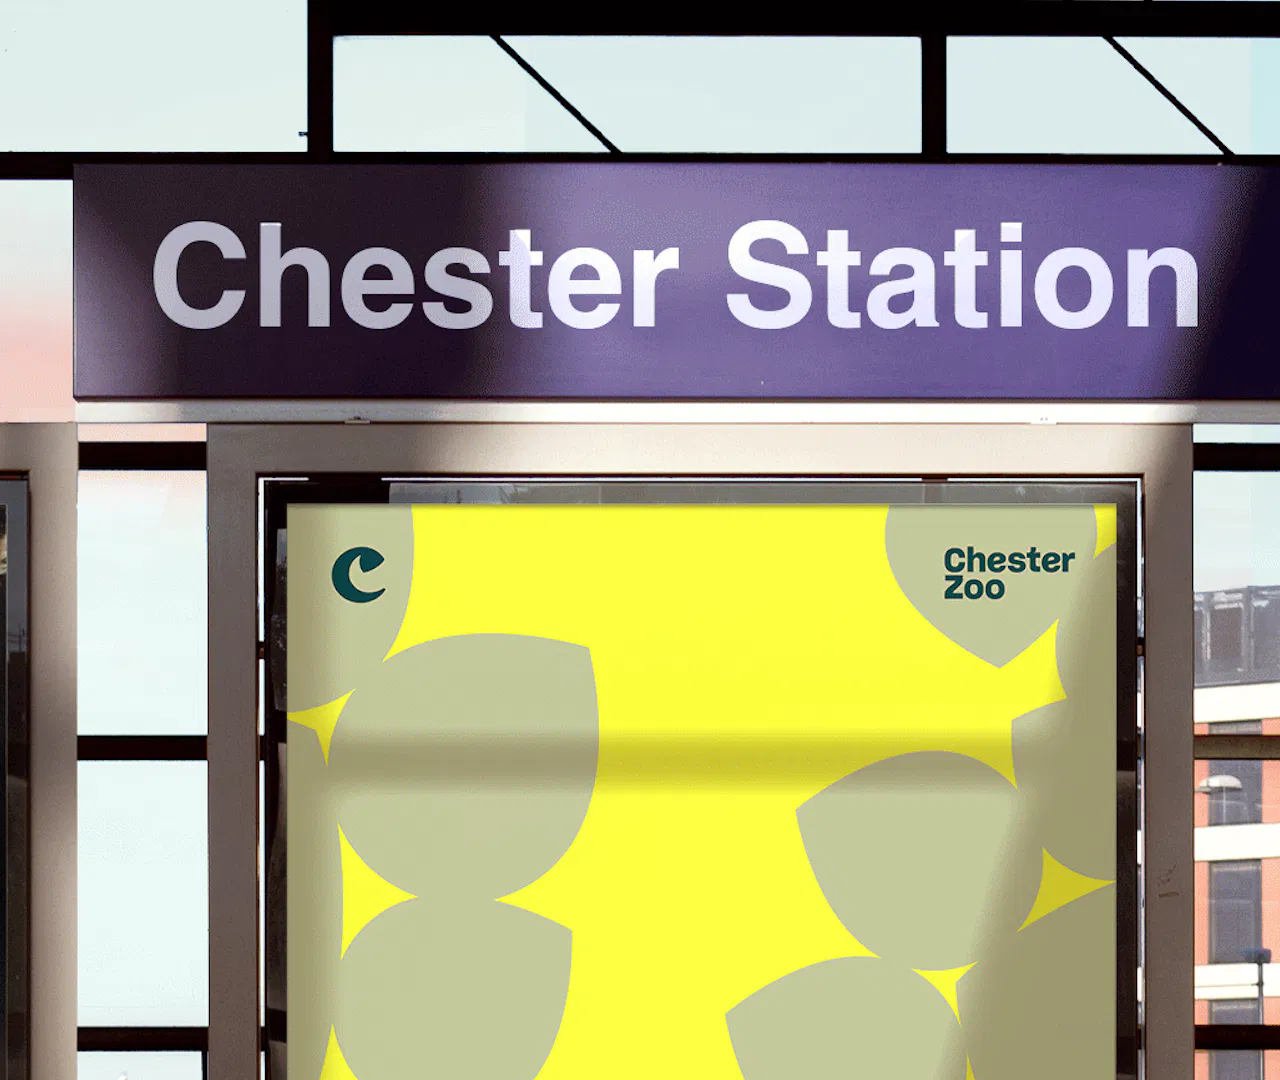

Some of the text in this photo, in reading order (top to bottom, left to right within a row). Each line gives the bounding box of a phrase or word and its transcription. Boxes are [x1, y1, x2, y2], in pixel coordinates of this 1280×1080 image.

[152, 219, 1200, 331] Chester Station
[944, 546, 1076, 573] Chester
[944, 574, 1005, 600] Zoo
